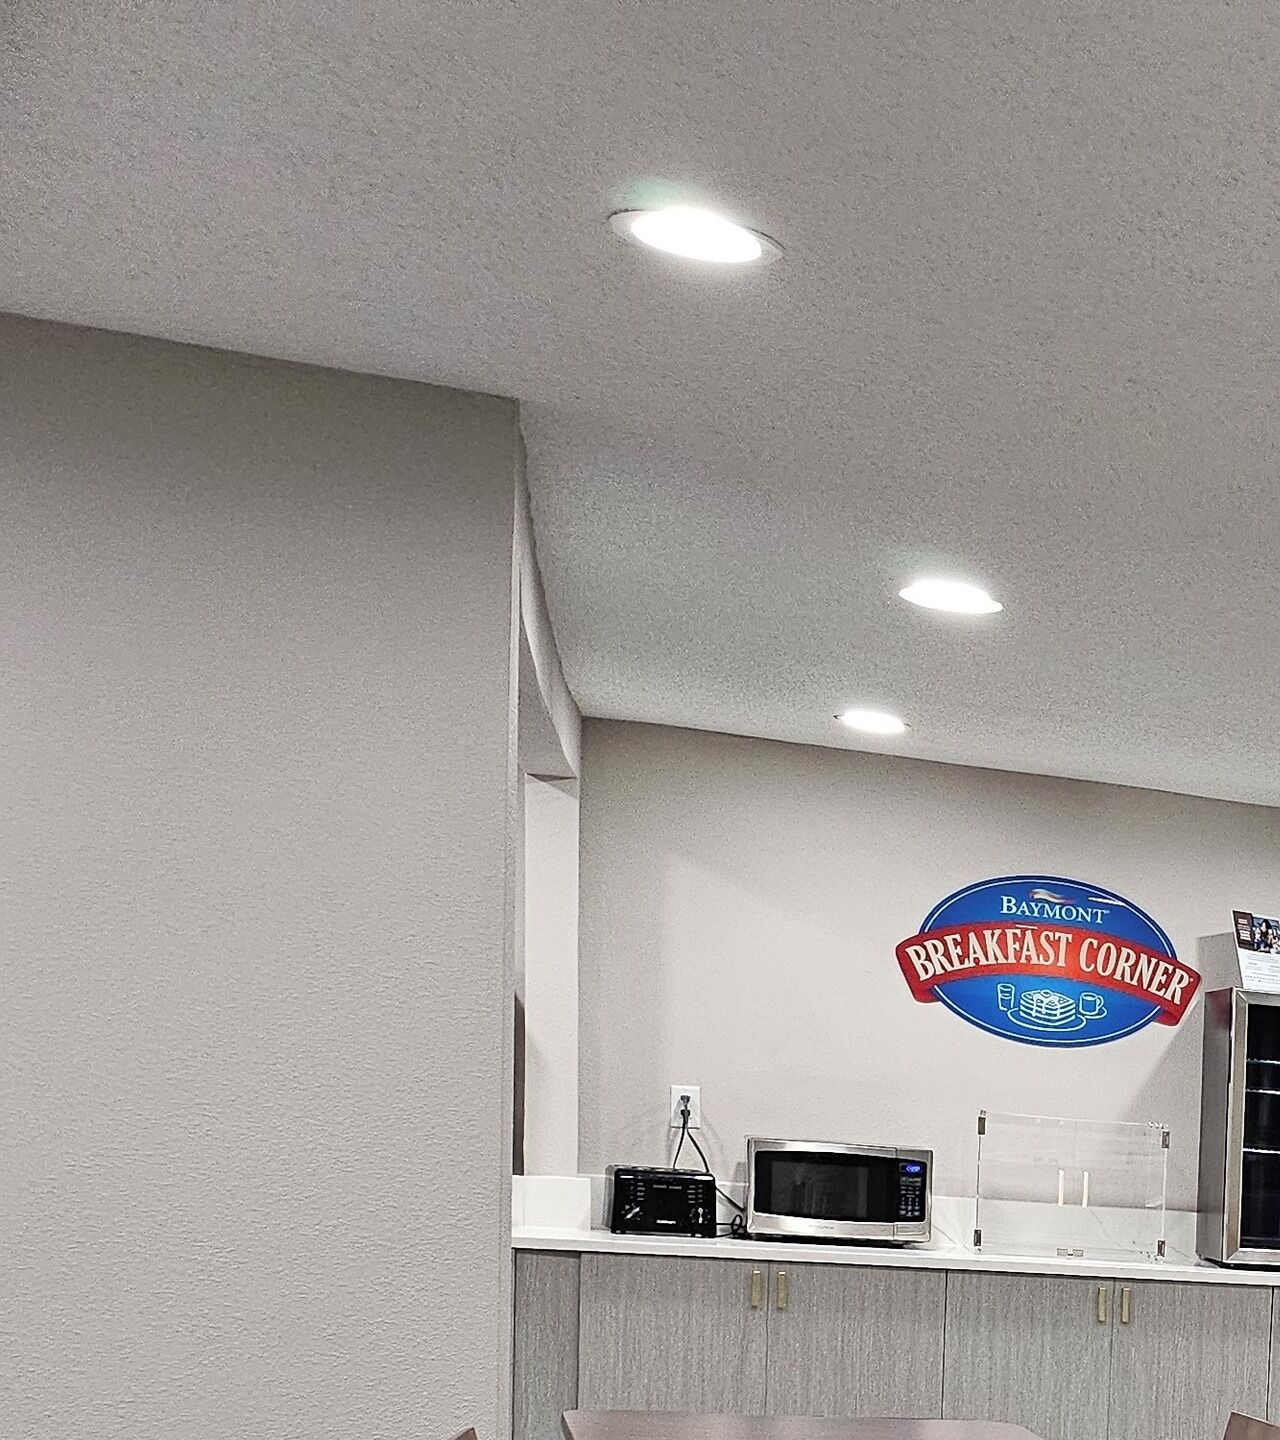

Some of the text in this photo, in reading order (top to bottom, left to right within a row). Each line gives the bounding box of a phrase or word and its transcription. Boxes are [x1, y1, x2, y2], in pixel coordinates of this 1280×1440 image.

[1000, 896, 1106, 924] BAYMONT
[906, 929, 1072, 981] BREAKFAST
[1079, 937, 1190, 1005] CORNER
